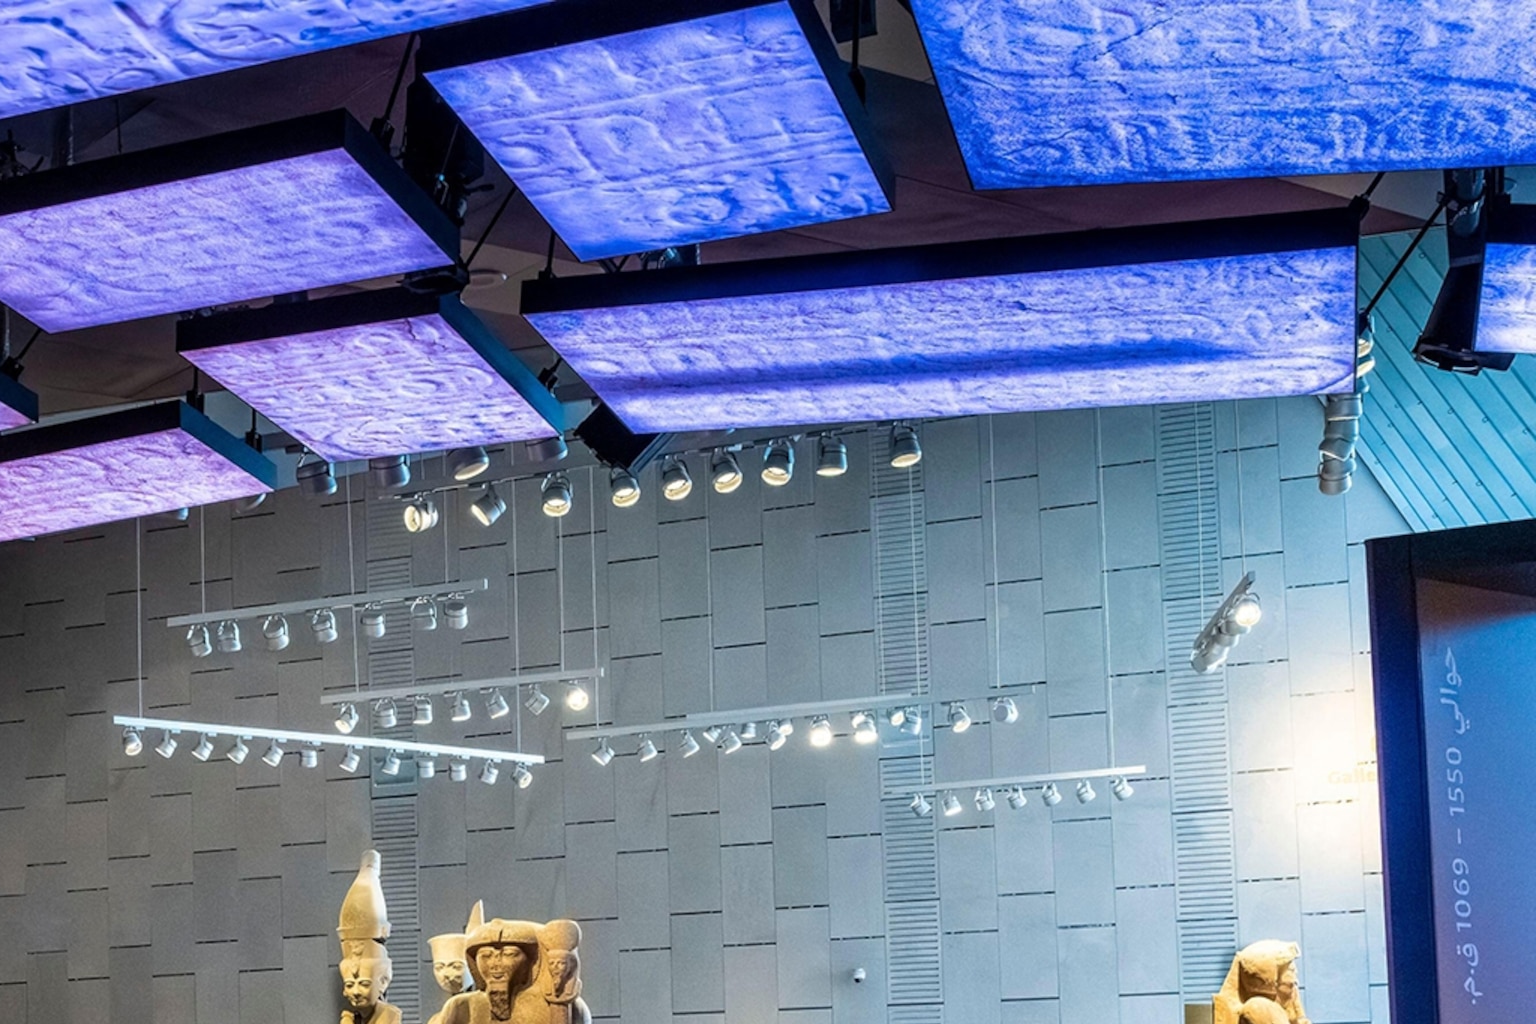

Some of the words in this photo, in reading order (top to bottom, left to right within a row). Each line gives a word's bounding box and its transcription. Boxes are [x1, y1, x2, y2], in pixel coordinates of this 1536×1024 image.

[1439, 646, 1473, 736] حوالي
[1445, 746, 1465, 817] 1550
[1452, 857, 1473, 932] 1069
